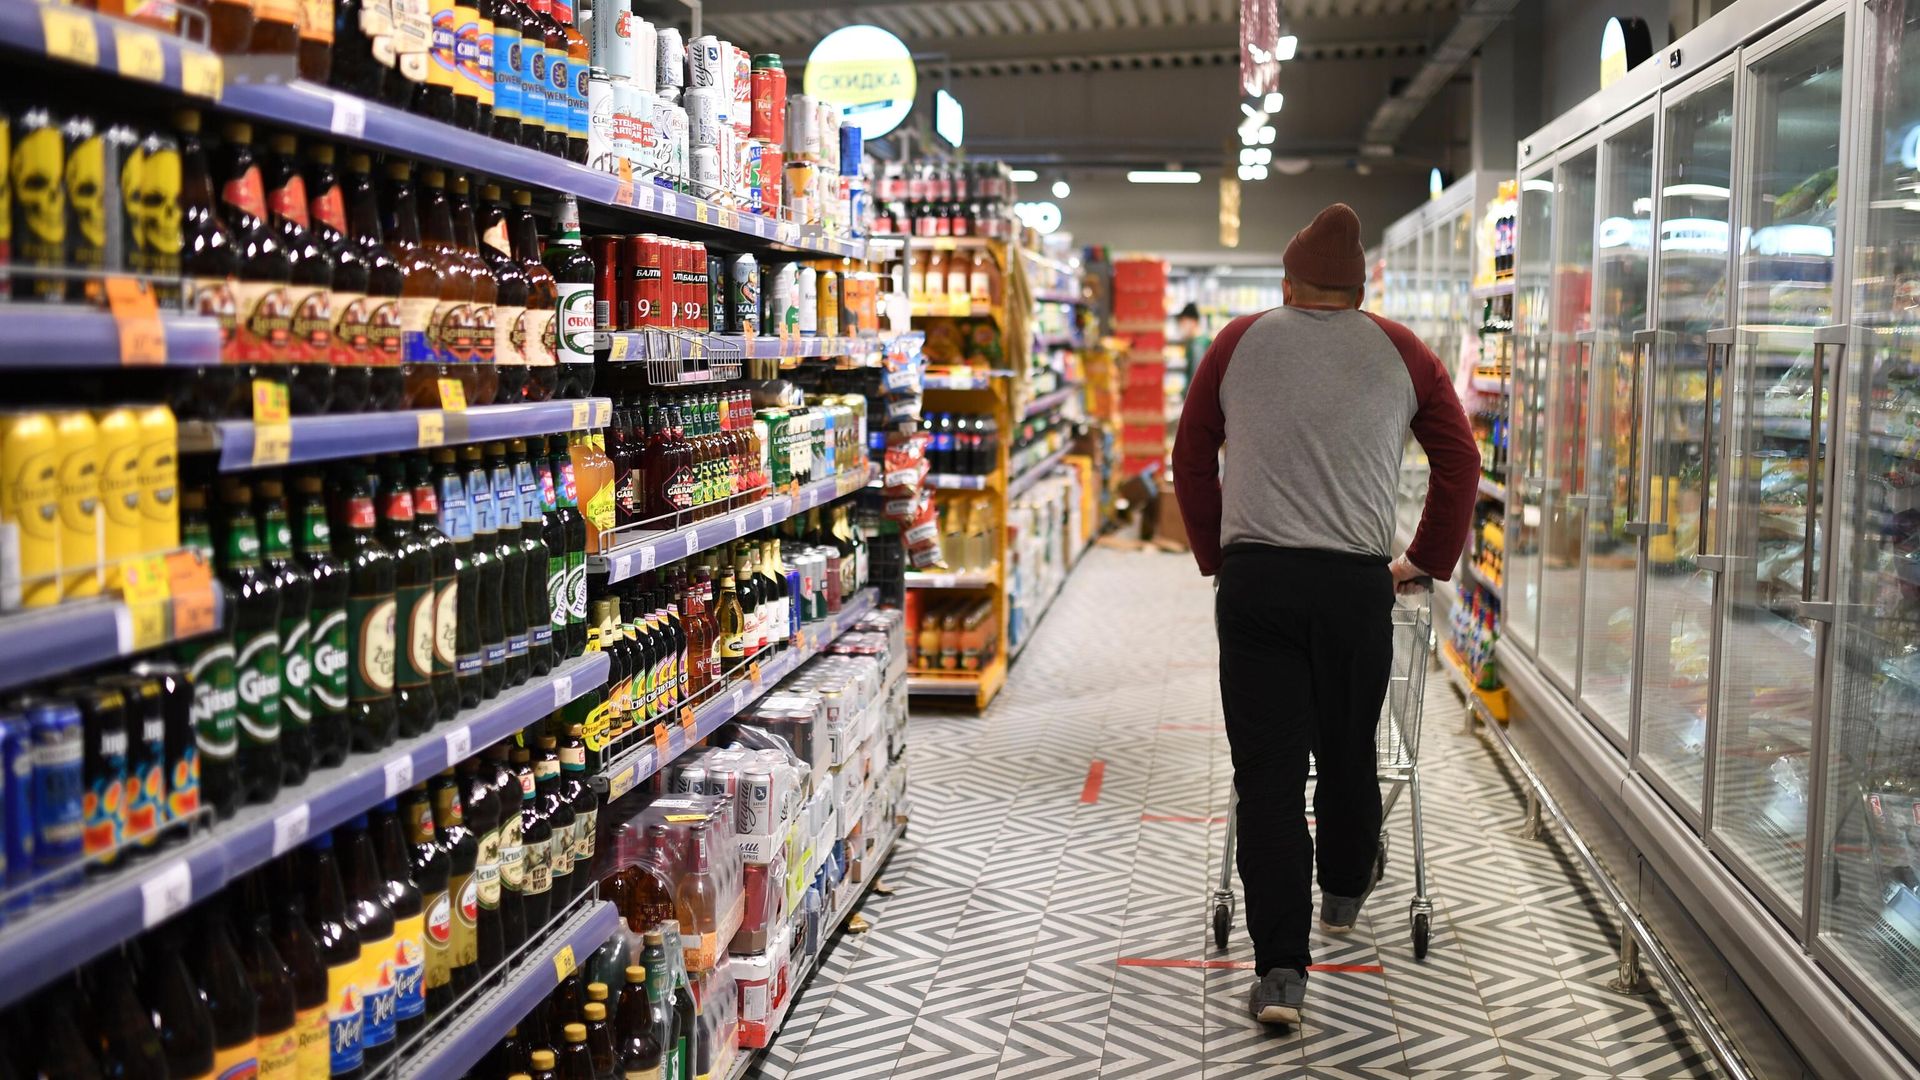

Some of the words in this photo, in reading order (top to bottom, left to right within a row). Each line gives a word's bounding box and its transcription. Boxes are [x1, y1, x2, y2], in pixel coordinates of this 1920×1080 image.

[817, 72, 902, 90] СКИДКА
[637, 299, 650, 319] 9
[501, 507, 511, 524] 7
[524, 500, 533, 517] 7
[447, 518, 457, 537] 7
[477, 511, 487, 529] 7
